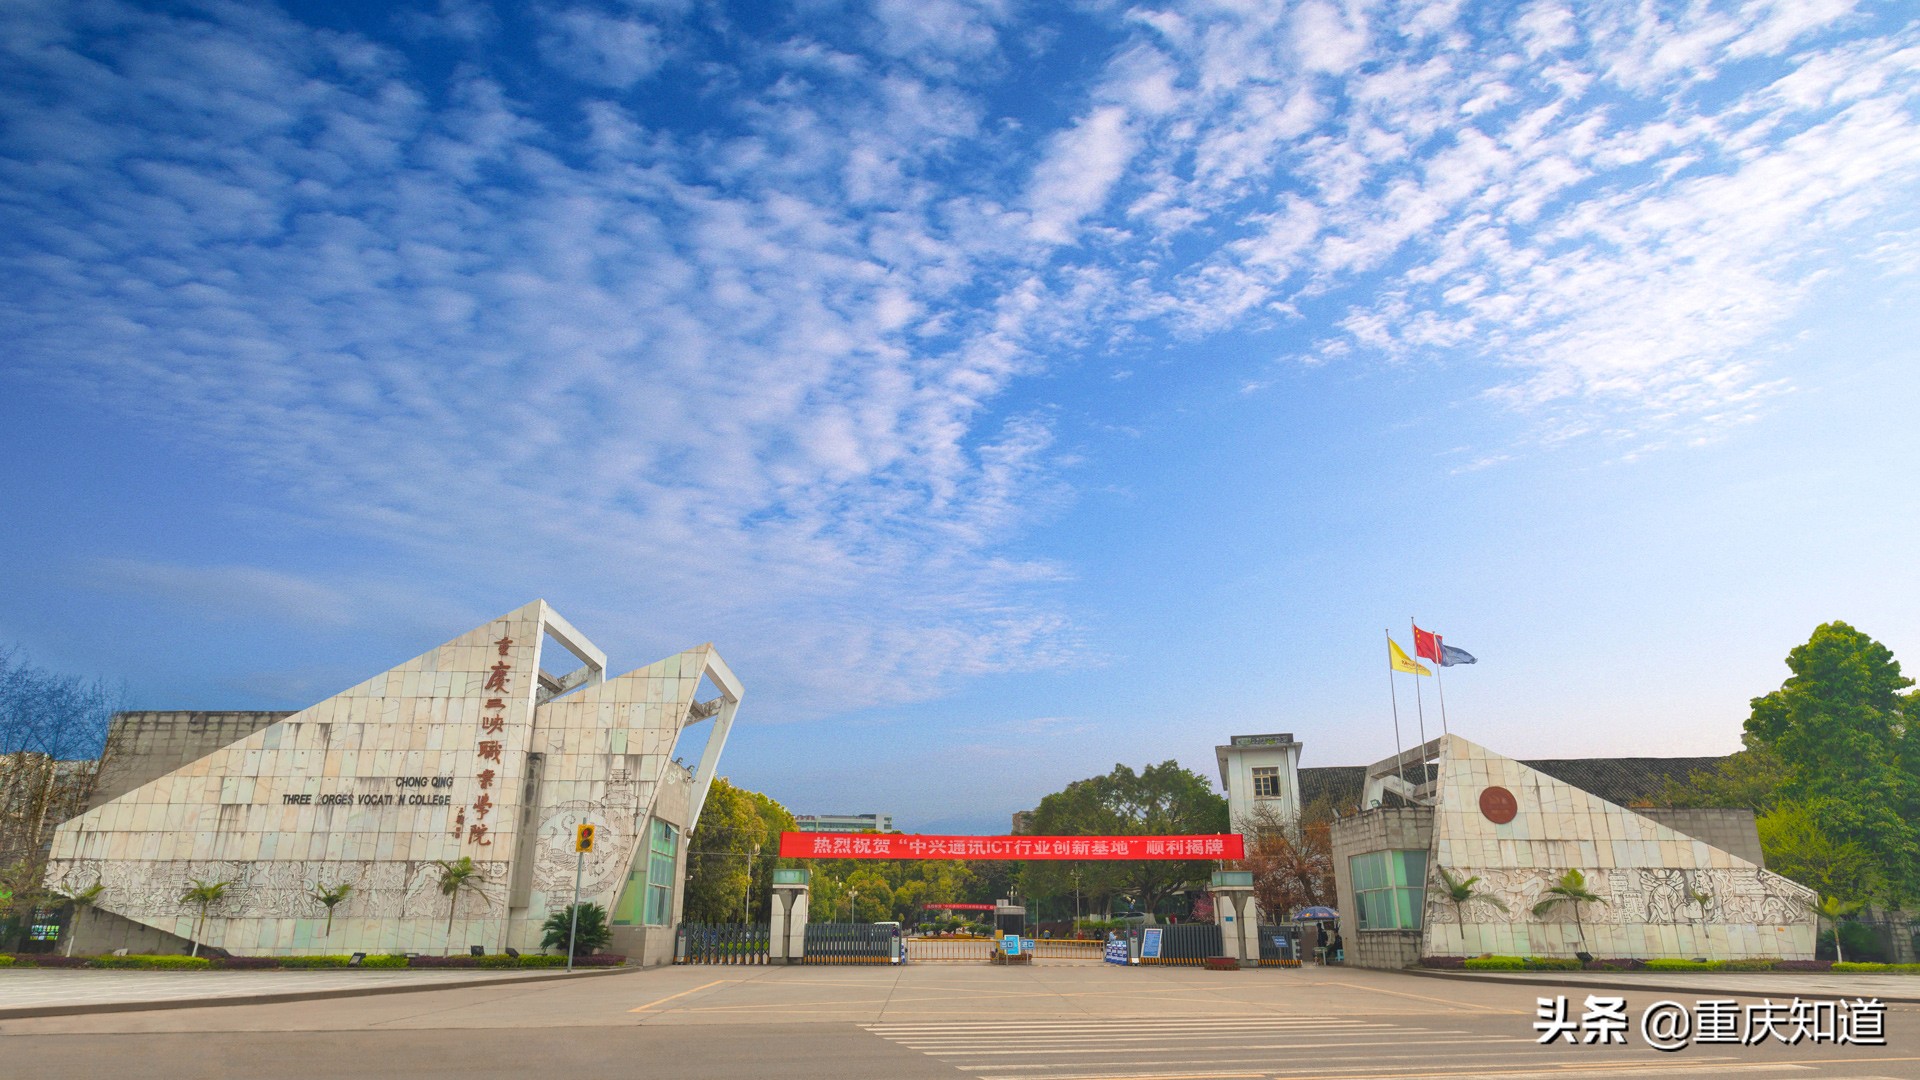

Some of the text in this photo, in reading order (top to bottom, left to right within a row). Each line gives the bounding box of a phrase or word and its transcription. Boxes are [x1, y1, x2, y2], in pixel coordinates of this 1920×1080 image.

[396, 776, 453, 787] CHONG QING
[282, 794, 451, 806] THREE ORGES VOCATIN COLLEGE
